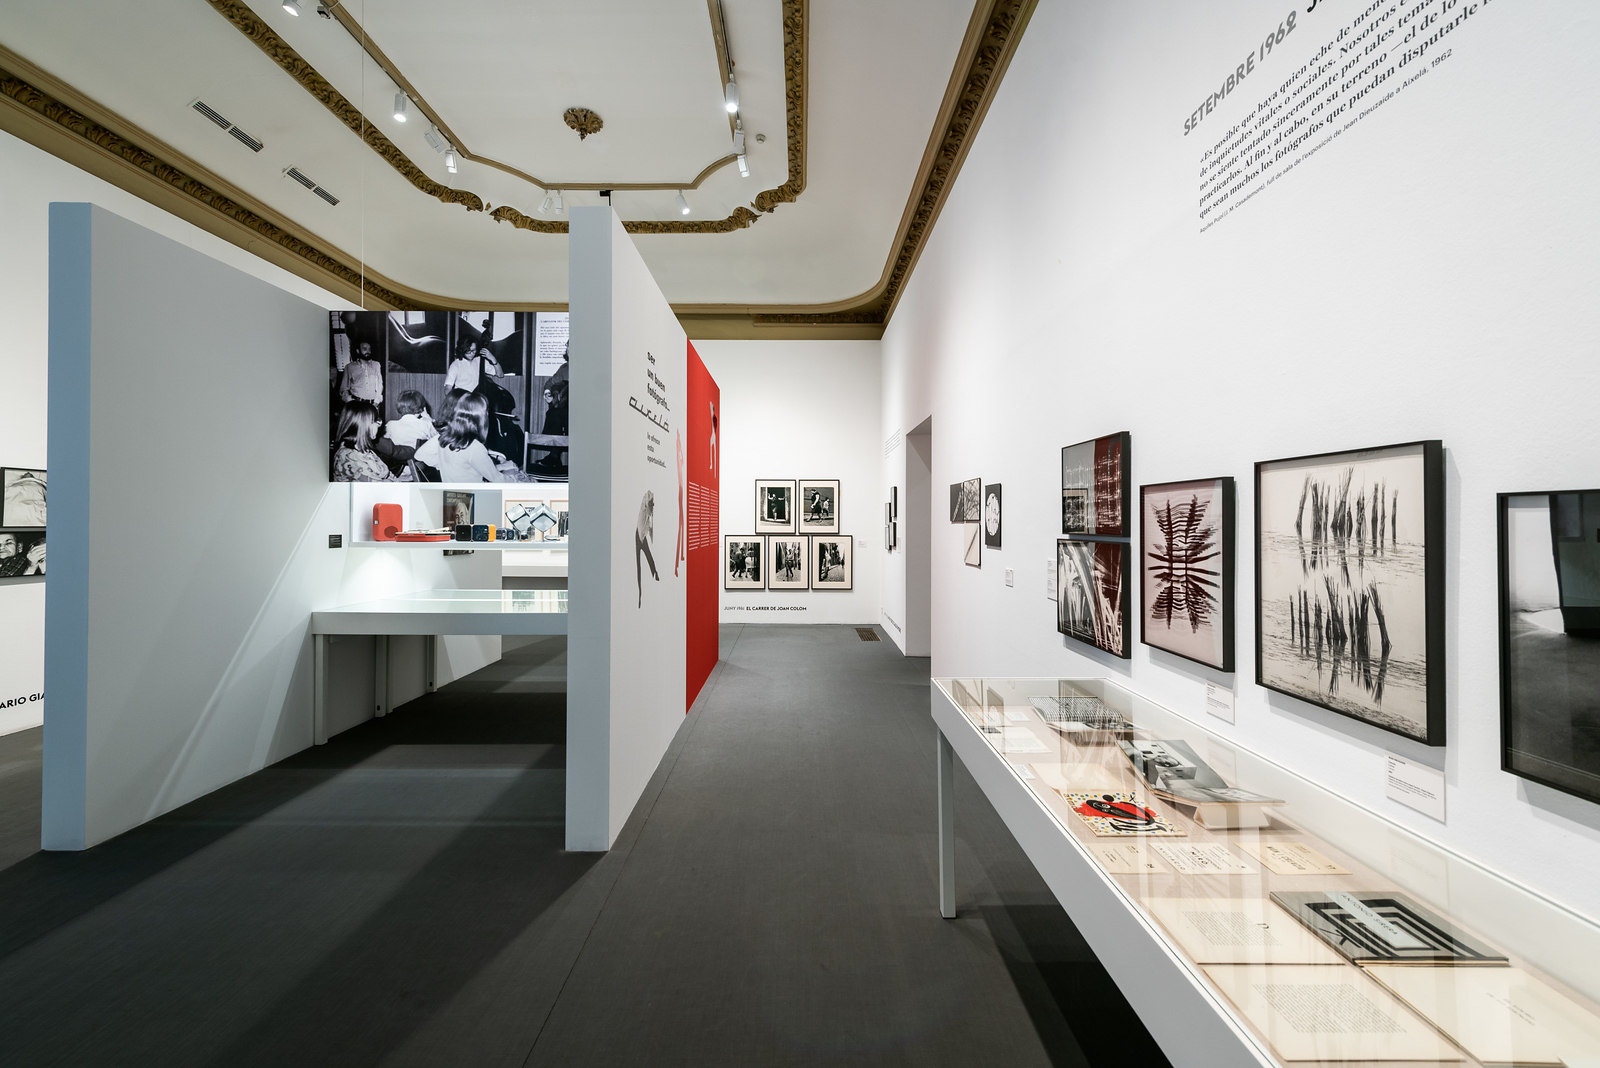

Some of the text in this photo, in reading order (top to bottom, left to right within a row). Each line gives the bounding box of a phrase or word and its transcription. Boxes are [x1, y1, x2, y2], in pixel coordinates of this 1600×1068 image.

[1184, 10, 1296, 136] SETEMBRE 1962
[1199, 180, 1208, 191] no
[1209, 173, 1217, 184] se
[1217, 155, 1239, 177] siente
[1240, 128, 1271, 158] tentado
[1272, 72, 1338, 132] sinceramente
[1341, 53, 1362, 79] por
[1364, 26, 1395, 56] tales
[1199, 168, 1242, 207] practicarlos.
[1244, 155, 1253, 170] Al
[1254, 149, 1266, 161] fin
[1266, 142, 1273, 154] y
[1273, 132, 1282, 146] al
[1283, 116, 1309, 138] cabo,
[1311, 102, 1324, 116] en
[1326, 90, 1338, 105] su
[1341, 53, 1387, 93] terreno
[1420, 12, 1438, 31] de
[1199, 3, 1478, 219] que sean muchos los fotógrafos que puedan disputarle
[1200, 5, 1396, 178] de inquietudes vitales o sociales. Nosotros
[1214, 125, 1240, 154] posible
[1241, 110, 1256, 128] que
[1258, 91, 1278, 112] haya
[1279, 65, 1307, 94] quien
[1309, 41, 1334, 66] eche
[1336, 26, 1350, 43] de
[1294, 158, 1301, 166] de
[1333, 128, 1342, 138] de
[1342, 117, 1358, 132] Jean
[1359, 91, 1395, 120] Dieuzaide
[1431, 48, 1453, 68] 1962
